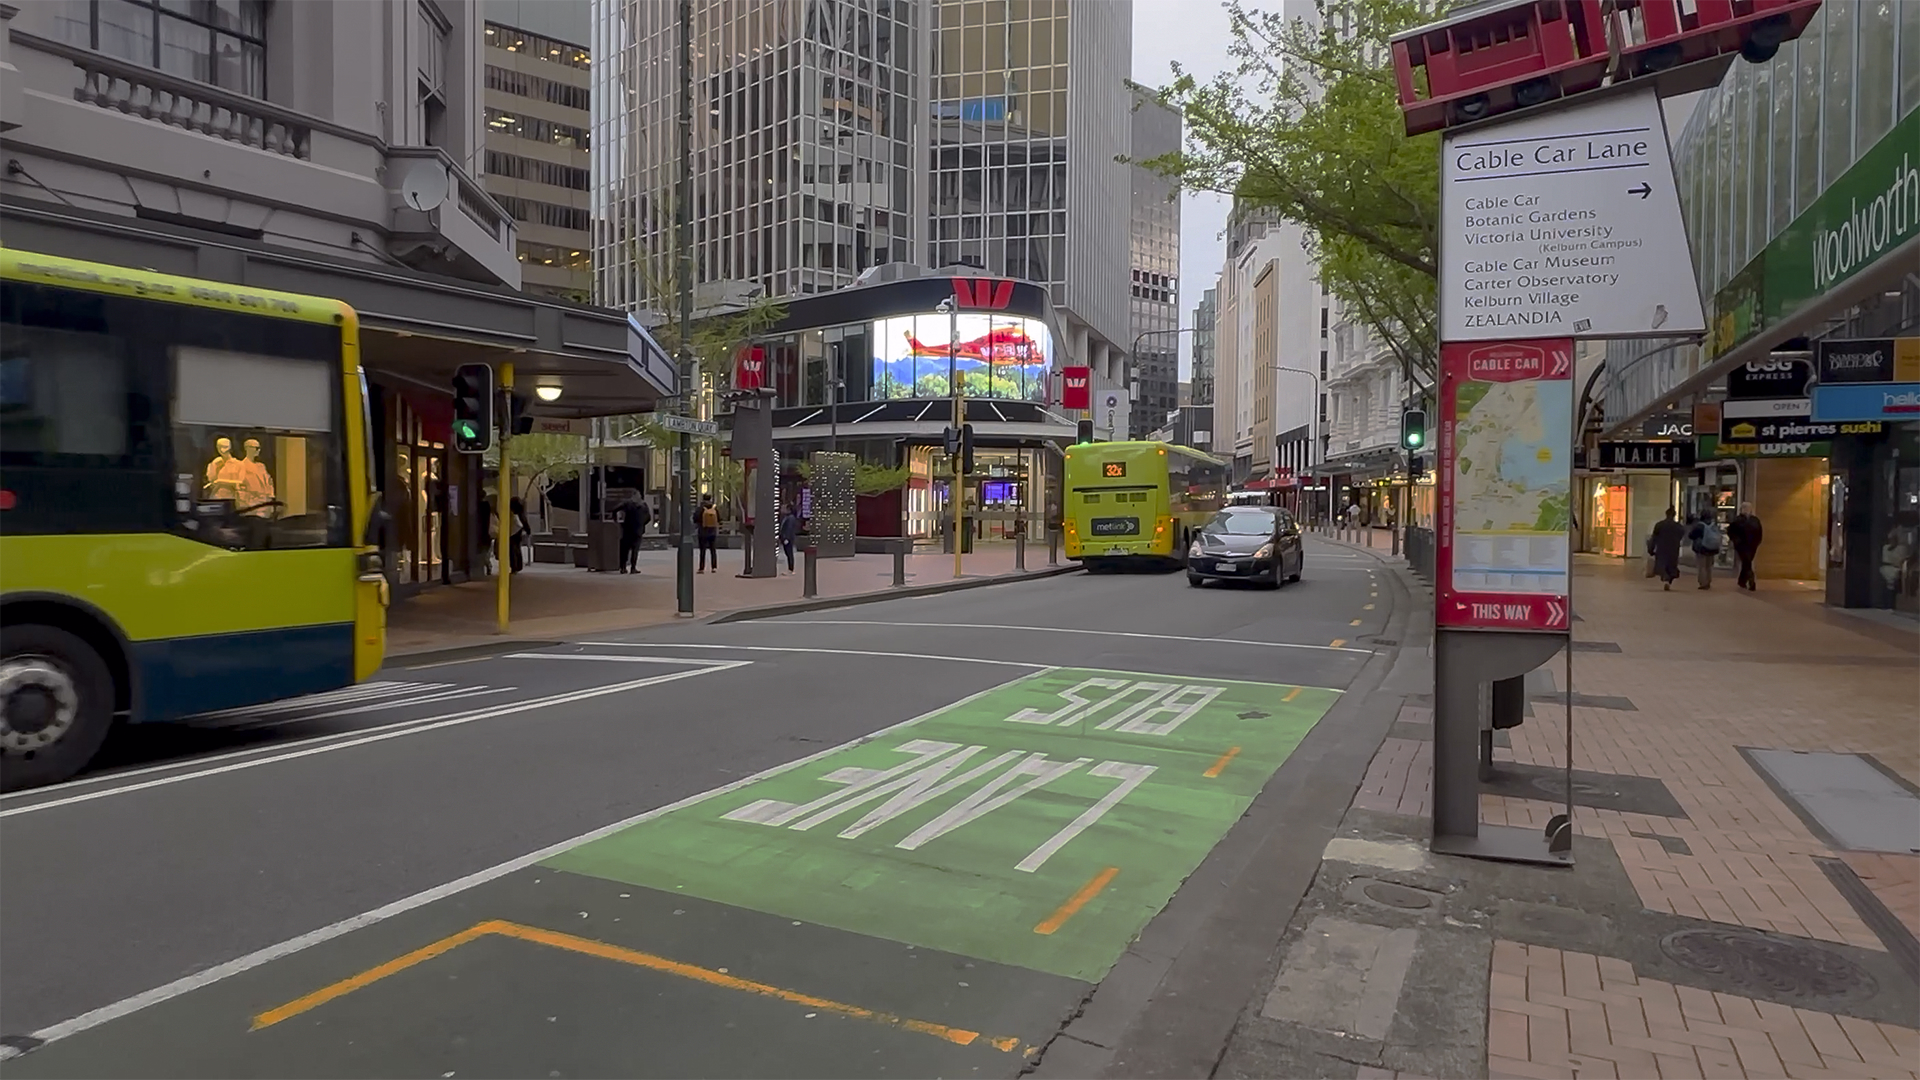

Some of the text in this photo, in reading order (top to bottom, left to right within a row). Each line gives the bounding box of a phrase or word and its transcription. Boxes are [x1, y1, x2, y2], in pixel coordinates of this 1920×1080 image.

[1456, 140, 1648, 171] Cable Car Lane
[1465, 194, 1541, 211] Cable Car
[1465, 208, 1597, 229] Botanic Gardens
[1812, 152, 1920, 290] woolworth
[1465, 225, 1613, 246] Victoria University
[1538, 238, 1643, 255] (Kelburn Campus)
[1464, 254, 1616, 274] Cable Car Museum
[1464, 272, 1620, 292] Carter Observatory
[1464, 291, 1580, 308] Kelburn Village
[1464, 310, 1563, 328] ZEALANDIA
[1473, 357, 1539, 371] CABLE CAR
[1745, 372, 1793, 382] EXPRESS
[1772, 402, 1800, 411] OPEN
[1761, 424, 1776, 436] st
[1779, 422, 1837, 439] pierres
[1840, 420, 1882, 434] sushi
[1614, 446, 1681, 464] MAHER
[1471, 602, 1532, 621] THIS WAY
[1003, 678, 1228, 736] BUS
[720, 738, 1159, 873] LANE
